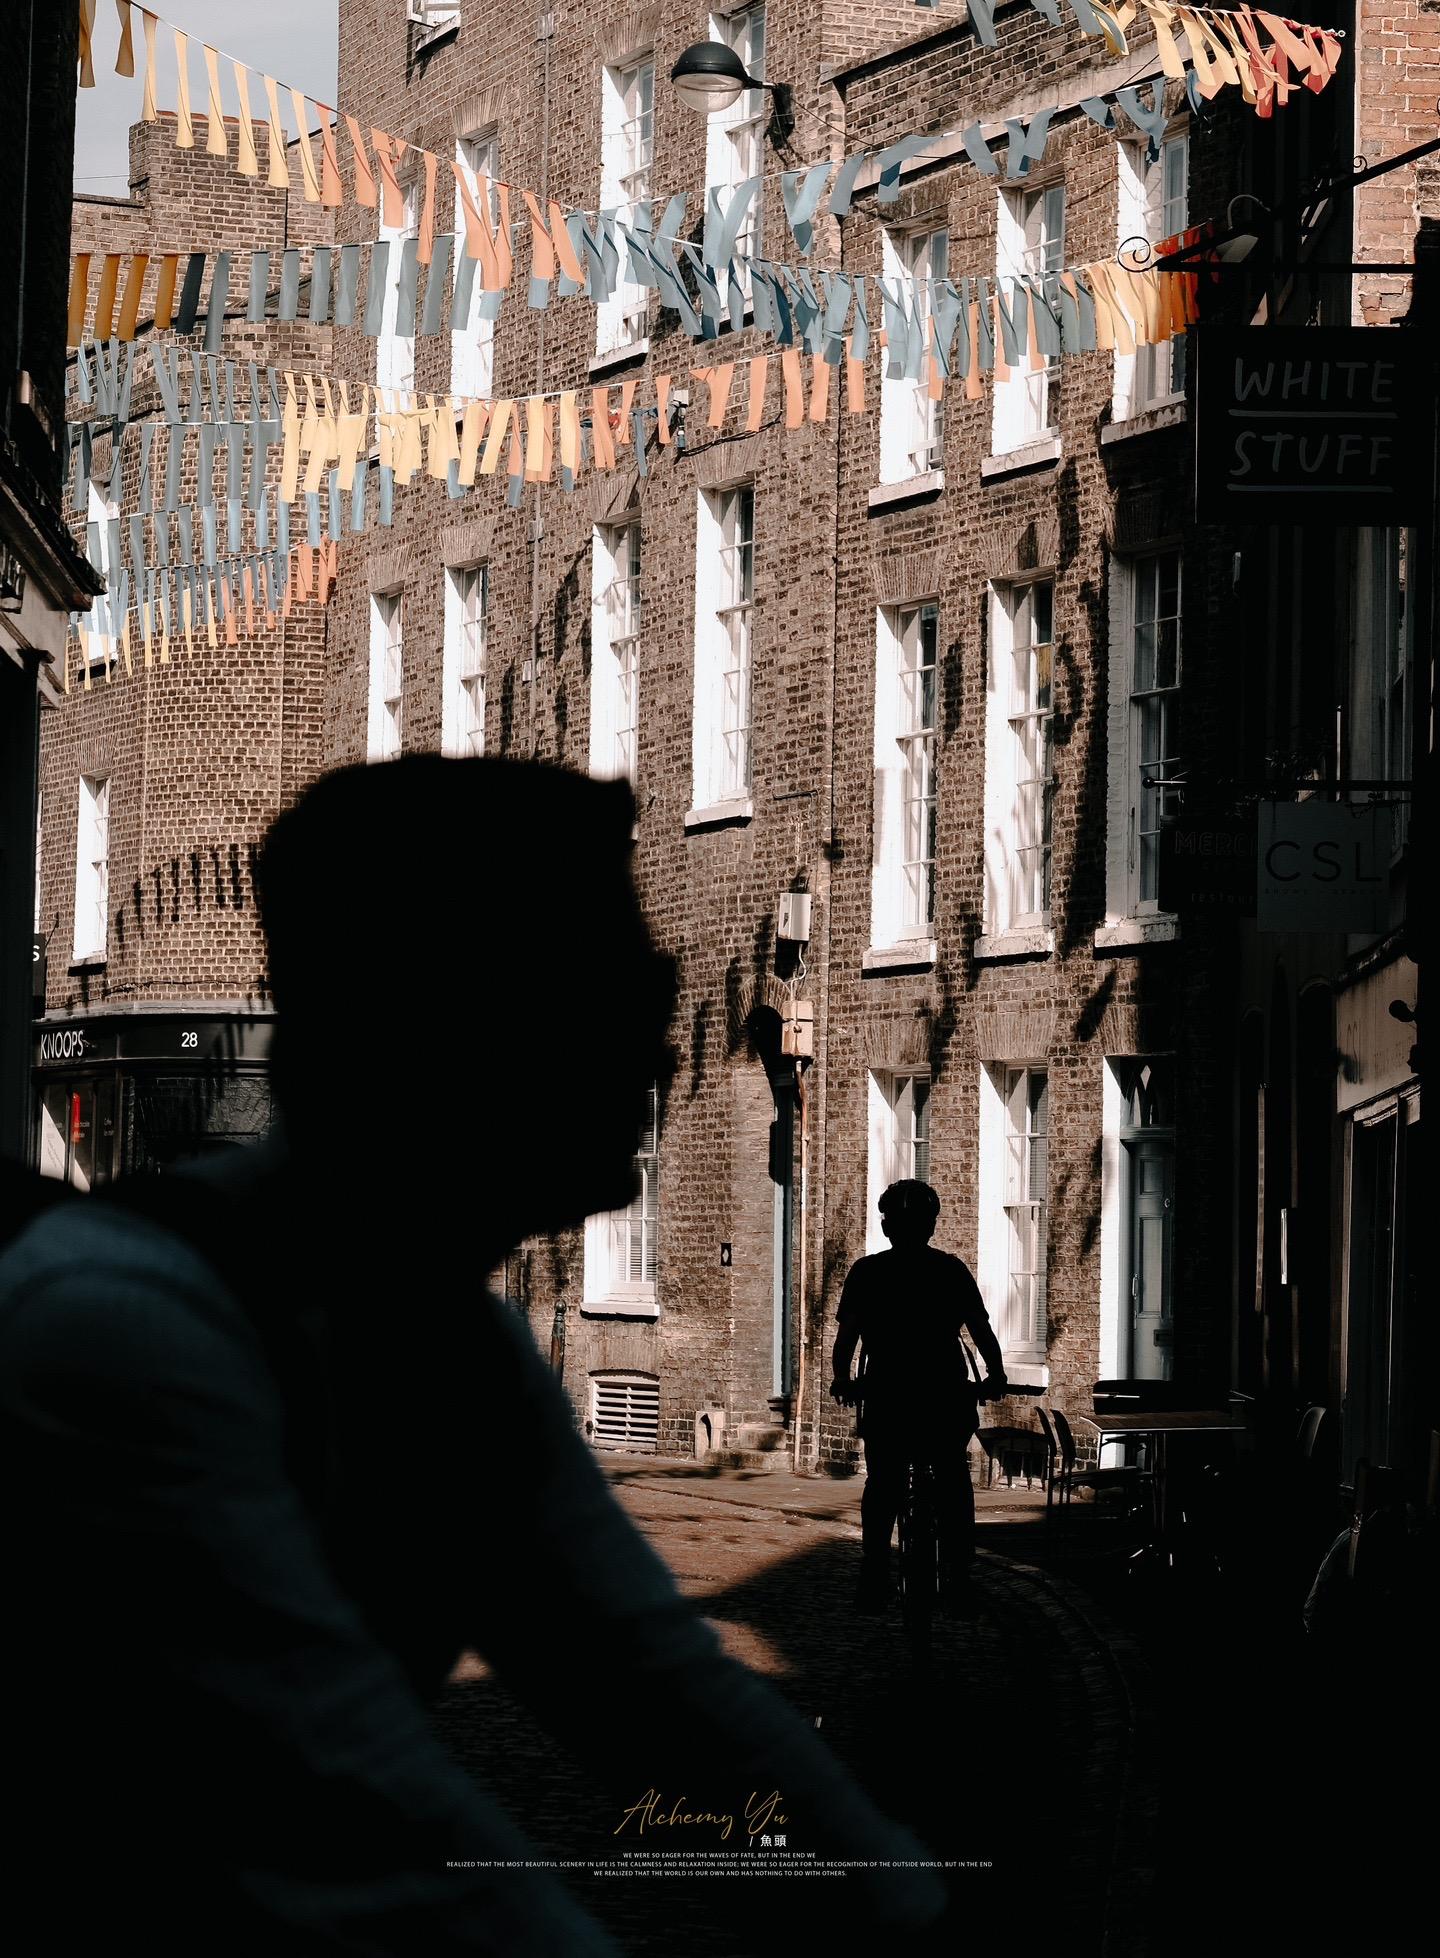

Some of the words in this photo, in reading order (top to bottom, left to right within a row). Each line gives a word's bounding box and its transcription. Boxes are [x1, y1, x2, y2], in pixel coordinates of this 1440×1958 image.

[1234, 357, 1395, 402] WHITE
[1229, 430, 1393, 476] STUFF
[1265, 840, 1382, 882] CSL
[40, 1030, 84, 1060] KNOOPS
[181, 1032, 198, 1048] 28
